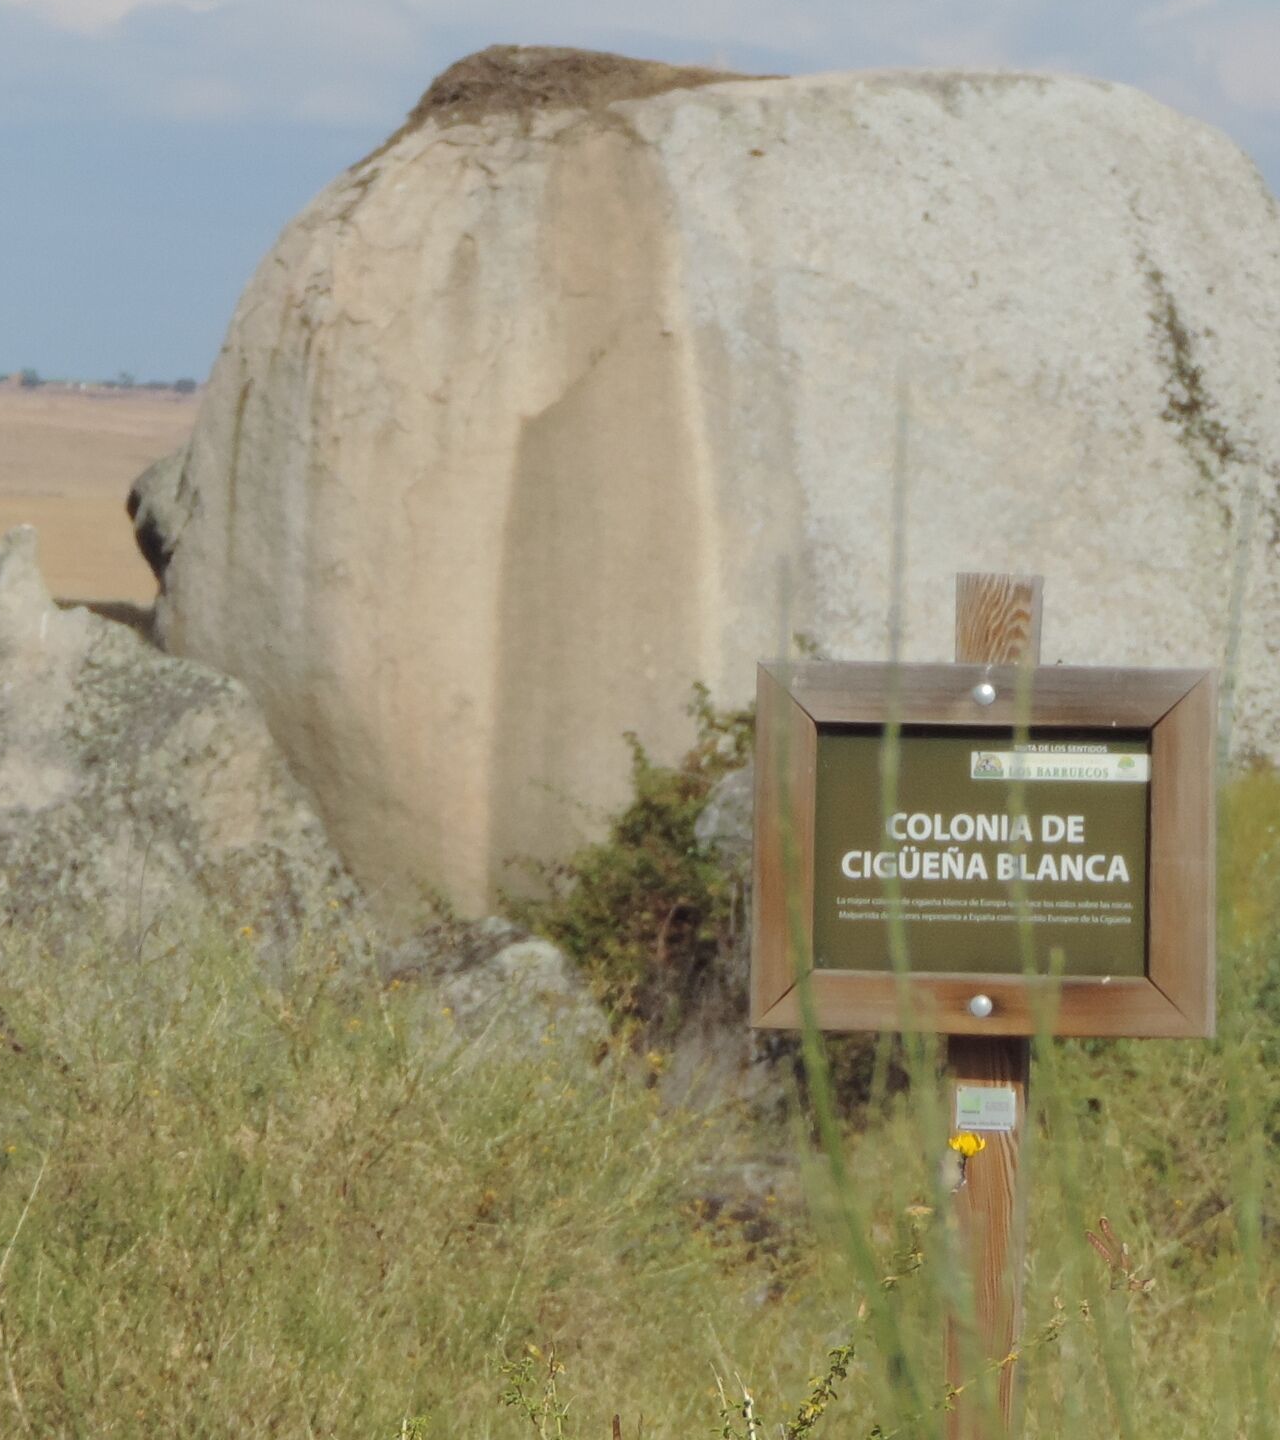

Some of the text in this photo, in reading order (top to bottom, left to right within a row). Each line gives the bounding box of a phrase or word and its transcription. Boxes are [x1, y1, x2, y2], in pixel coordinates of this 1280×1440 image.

[1051, 745, 1066, 753] LOS
[1068, 745, 1108, 753] SENTIDOS
[1036, 766, 1109, 779] BARRUECOS
[886, 813, 1085, 843] COLONIA DE
[841, 846, 1130, 882] CIGÜEÑA BLANCA
